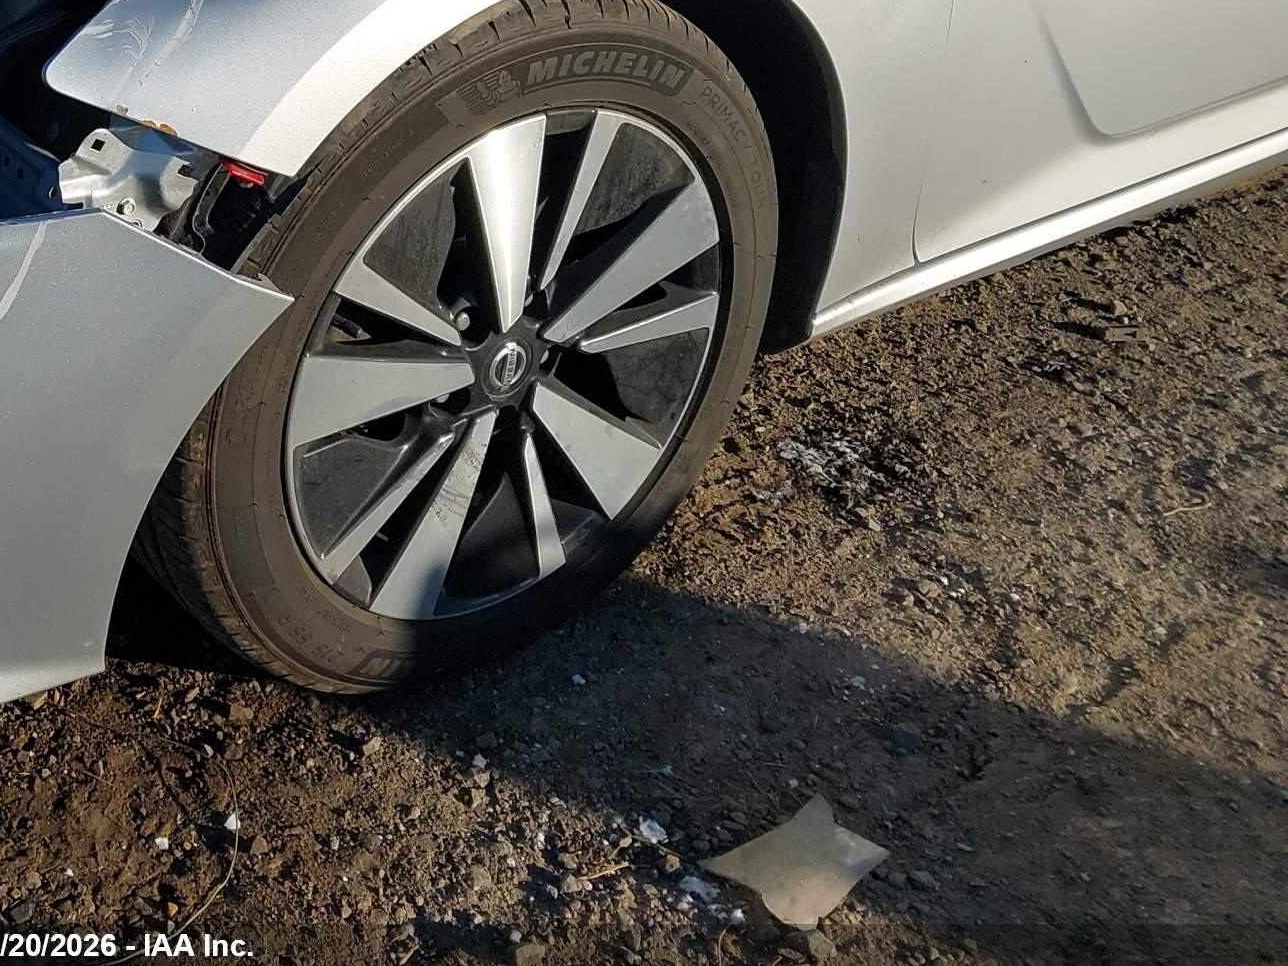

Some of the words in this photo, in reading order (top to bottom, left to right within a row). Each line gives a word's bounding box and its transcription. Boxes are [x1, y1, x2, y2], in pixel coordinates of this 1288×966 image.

[527, 50, 686, 90] MICHELIN
[698, 85, 753, 151] PRIMACY
[747, 156, 767, 208] TOUR
